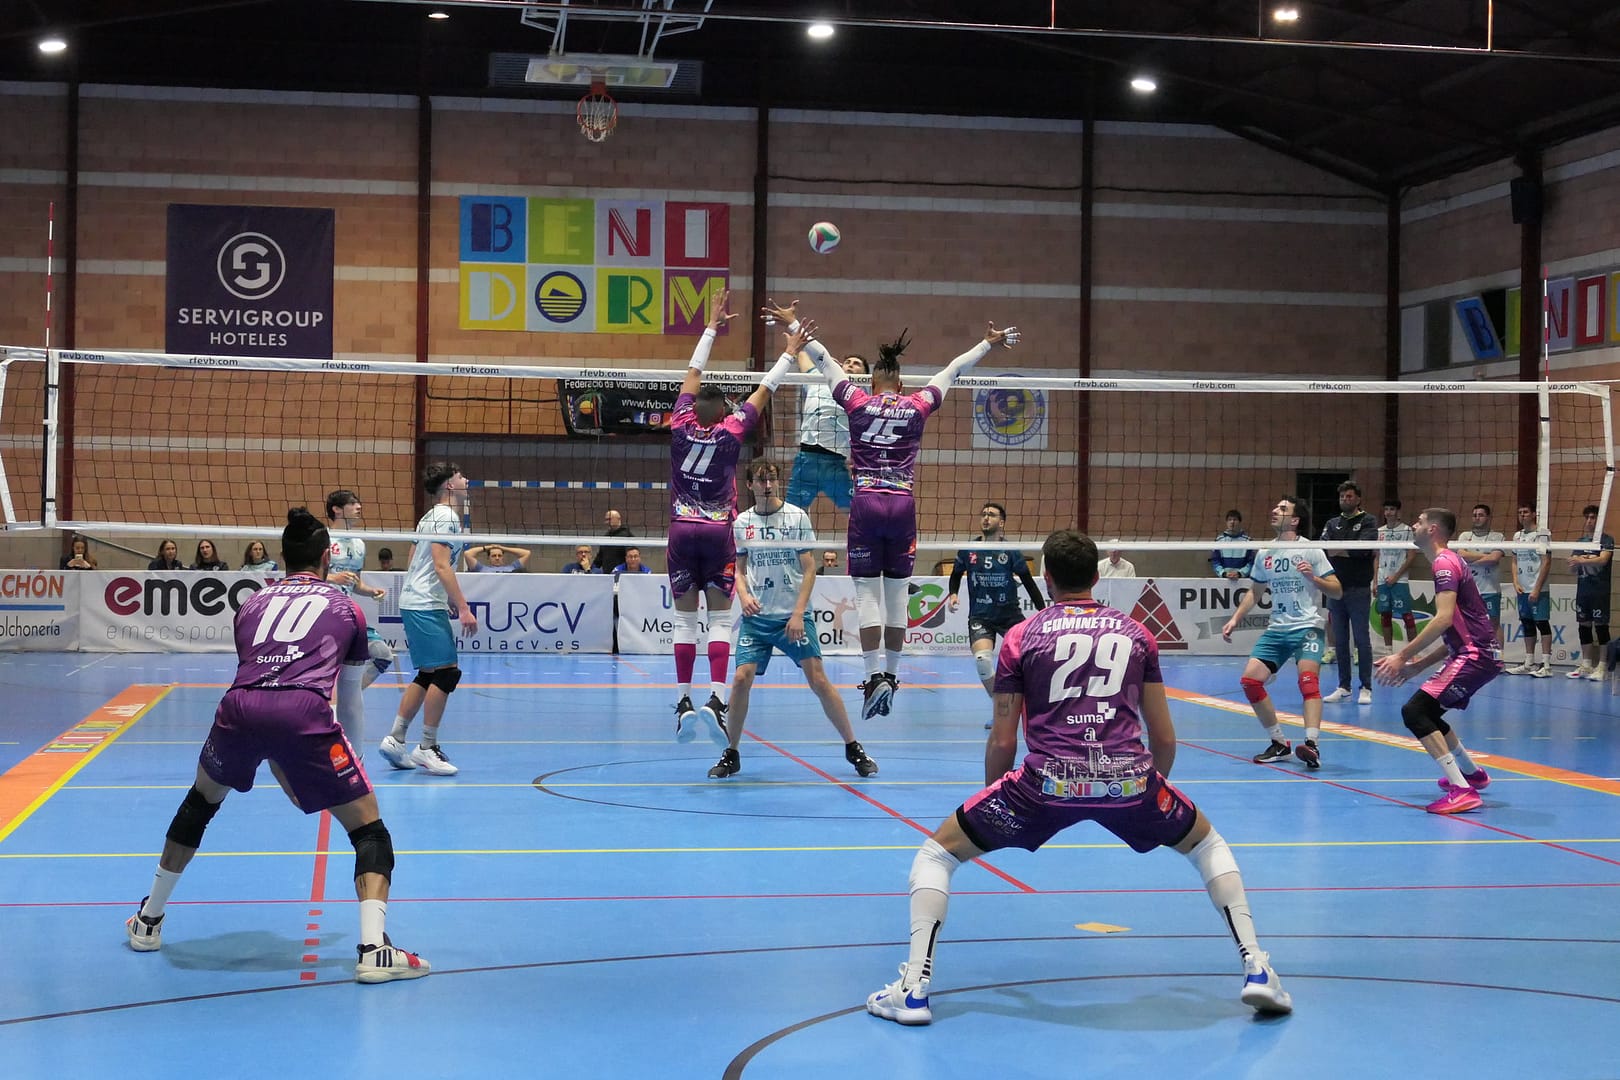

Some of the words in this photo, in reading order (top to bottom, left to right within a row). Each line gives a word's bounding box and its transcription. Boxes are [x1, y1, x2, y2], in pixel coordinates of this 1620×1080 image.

[471, 203, 710, 259] BENI
[177, 307, 324, 328] SERVIGROUP
[209, 331, 288, 347] HOTELES
[59, 351, 105, 361] fevb.com
[188, 356, 238, 366] rfevb.com
[321, 361, 370, 371] rfevb.com
[451, 365, 500, 375] rfevb.com
[579, 369, 627, 378] rfevb.com
[705, 373, 752, 381] rfevb.com
[952, 377, 998, 387] rfevb.com
[1073, 379, 1118, 389] rfevb.com
[1192, 381, 1236, 391] rfevb.com
[1308, 382, 1352, 391] rfevb.com
[1423, 382, 1465, 391] rfevb.com
[621, 399, 674, 410] www.fvbcv.
[860, 418, 909, 445] 15
[680, 443, 718, 475] 11
[760, 526, 776, 540] 15
[984, 556, 993, 570] 5
[1274, 557, 1290, 573] 20
[0, 570, 65, 599] CHÓN
[251, 594, 331, 647] 10
[1042, 615, 1123, 634] CUMINETTI
[106, 624, 232, 644] emecspor
[1302, 642, 1319, 653] 20
[256, 653, 292, 664] suma
[1048, 632, 1134, 704] 29
[1066, 713, 1105, 725] suma
